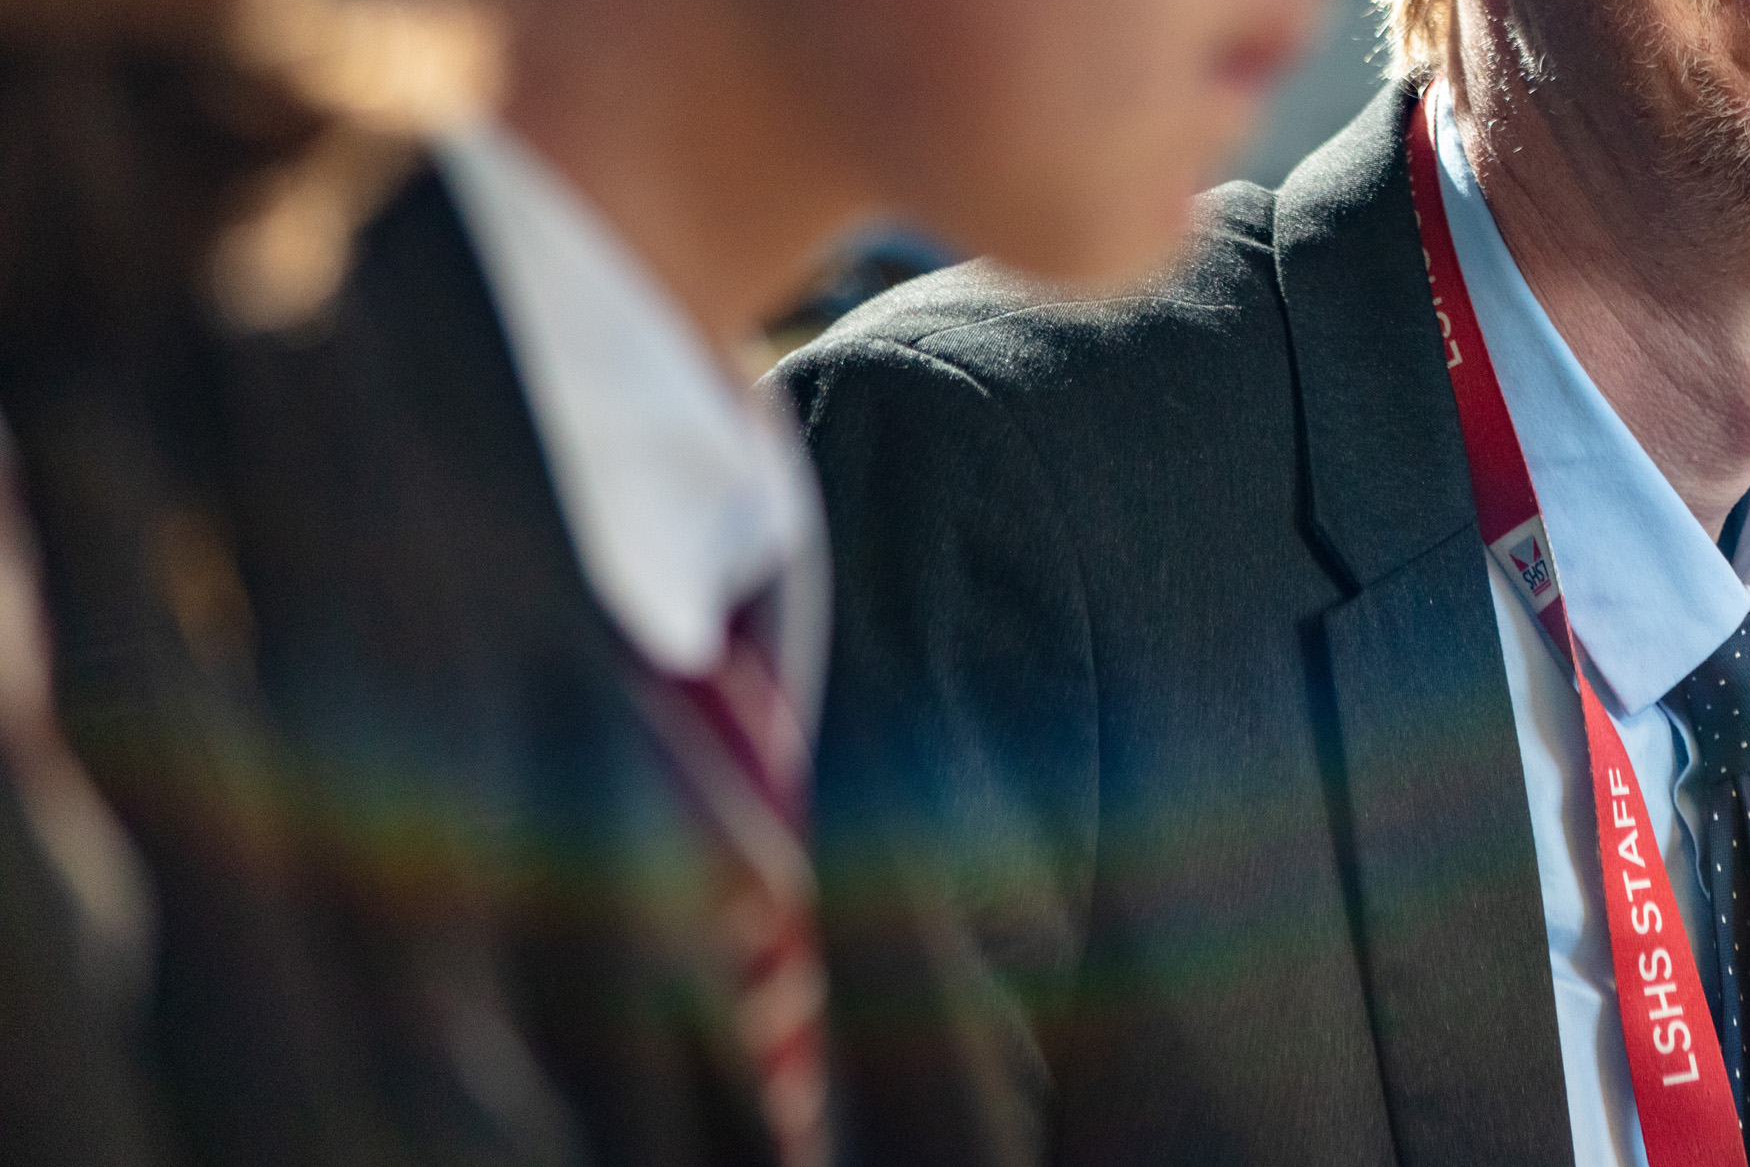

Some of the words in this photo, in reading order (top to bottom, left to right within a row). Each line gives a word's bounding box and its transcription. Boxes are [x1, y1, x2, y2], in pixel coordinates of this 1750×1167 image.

[1522, 559, 1550, 591] LSHS
[1608, 767, 1663, 935] STAFF
[1638, 947, 1700, 1087] LSHS
